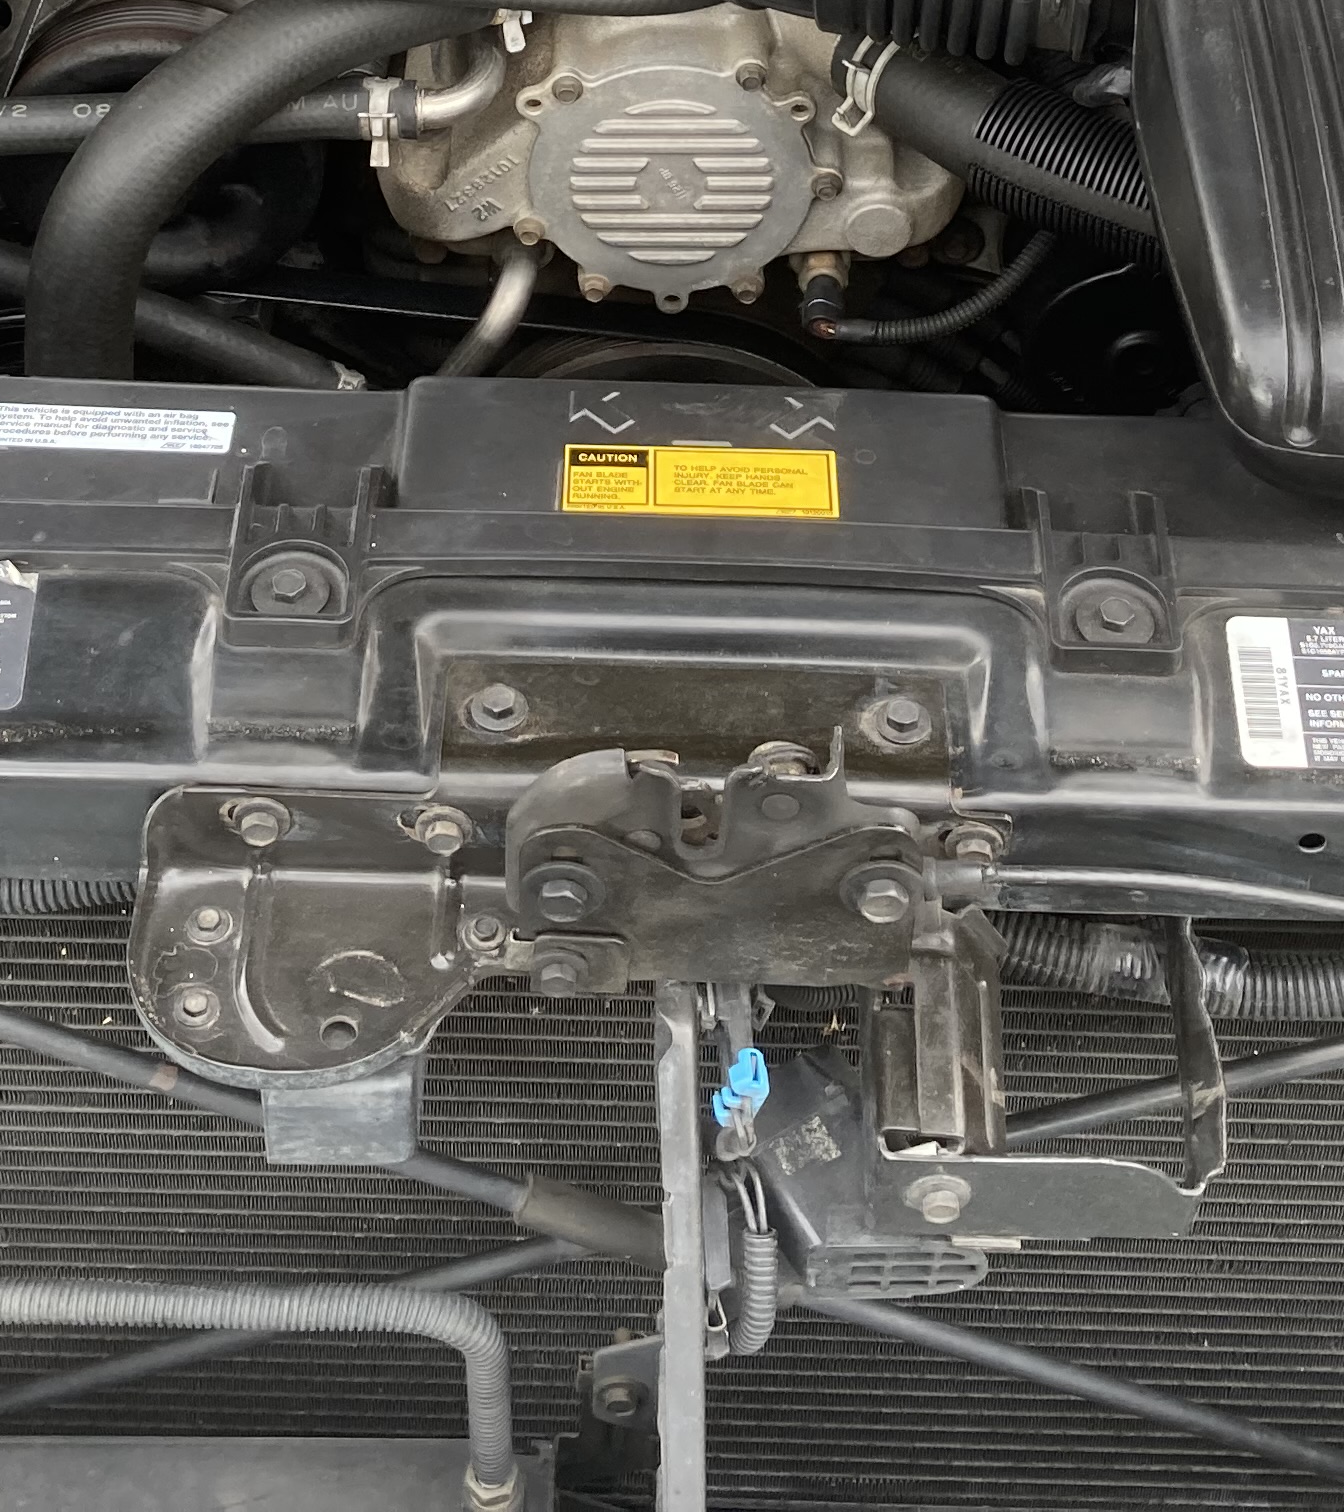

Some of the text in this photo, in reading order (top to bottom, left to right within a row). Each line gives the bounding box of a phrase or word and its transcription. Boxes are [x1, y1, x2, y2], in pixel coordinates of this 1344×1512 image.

[323, 94, 358, 111] AU
[39, 413, 52, 421] To
[55, 414, 77, 423] help
[110, 417, 161, 425] unwanted
[72, 408, 121, 417] equipped
[124, 409, 145, 417] with
[179, 411, 199, 420] bag
[33, 420, 72, 428] manual
[91, 424, 146, 432] diagnostic
[53, 428, 87, 437] before
[89, 431, 147, 440] performing
[149, 433, 169, 441] any
[578, 453, 638, 463] CAUTION
[1313, 626, 1336, 635] YAX
[1306, 693, 1322, 701] NO
[1308, 709, 1328, 718] SEE
